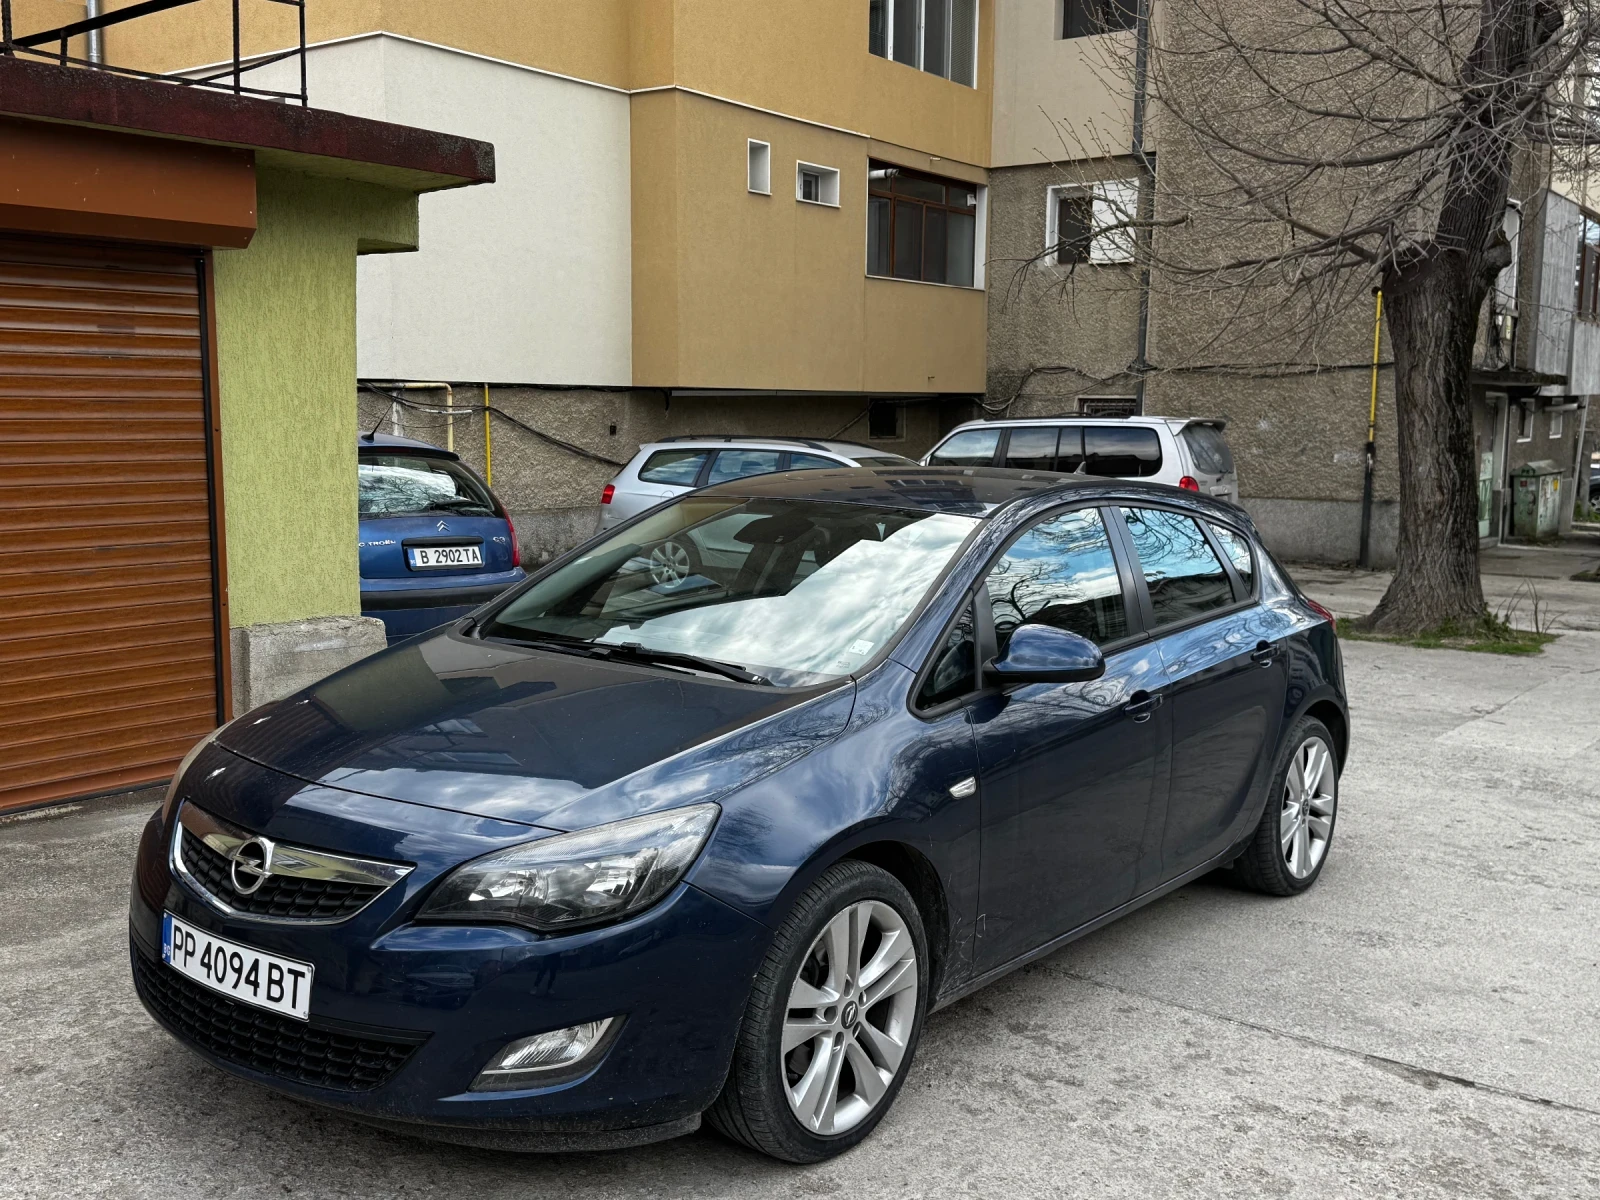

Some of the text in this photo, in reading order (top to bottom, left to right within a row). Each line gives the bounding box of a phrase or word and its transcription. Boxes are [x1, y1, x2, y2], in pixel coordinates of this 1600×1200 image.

[358, 539, 396, 547] CTROËN
[200, 941, 260, 997] 4094
[266, 962, 306, 1009] BT
